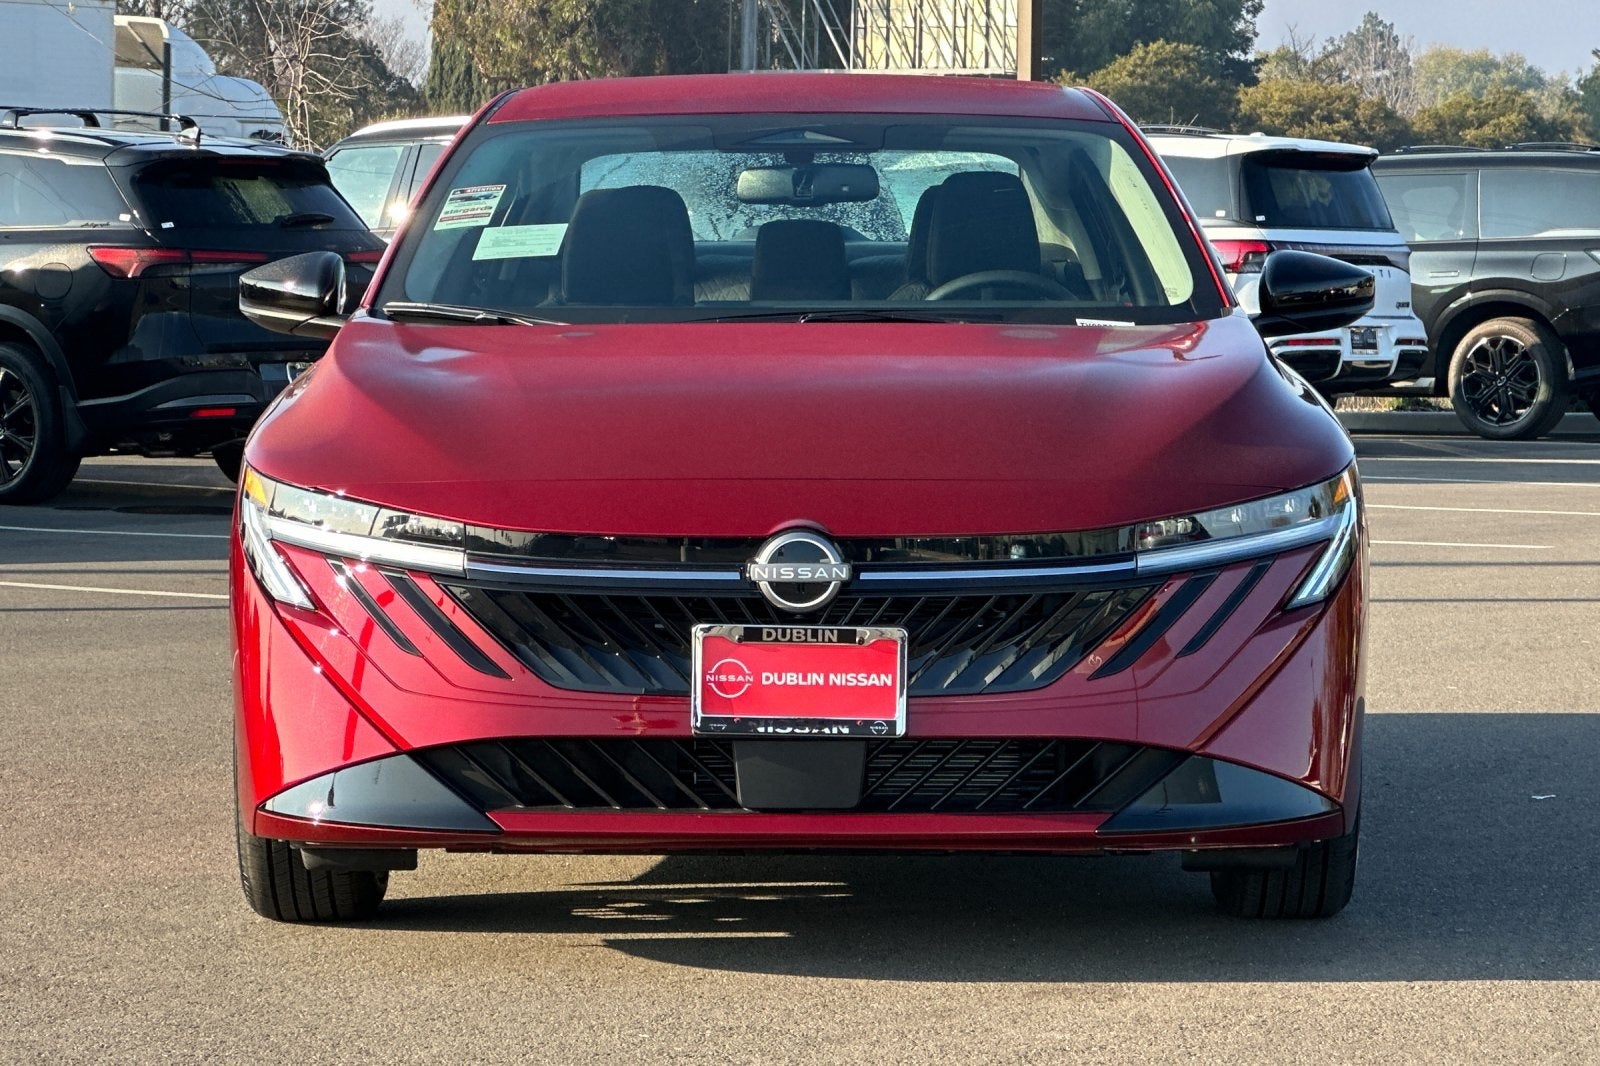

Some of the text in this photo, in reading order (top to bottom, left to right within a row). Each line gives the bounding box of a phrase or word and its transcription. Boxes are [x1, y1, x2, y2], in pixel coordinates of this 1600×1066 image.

[754, 567, 846, 578] NISSAN
[762, 628, 838, 642] DUBLIN
[705, 674, 754, 682] NISSAN
[761, 672, 892, 686] DUBLIN NISSAN
